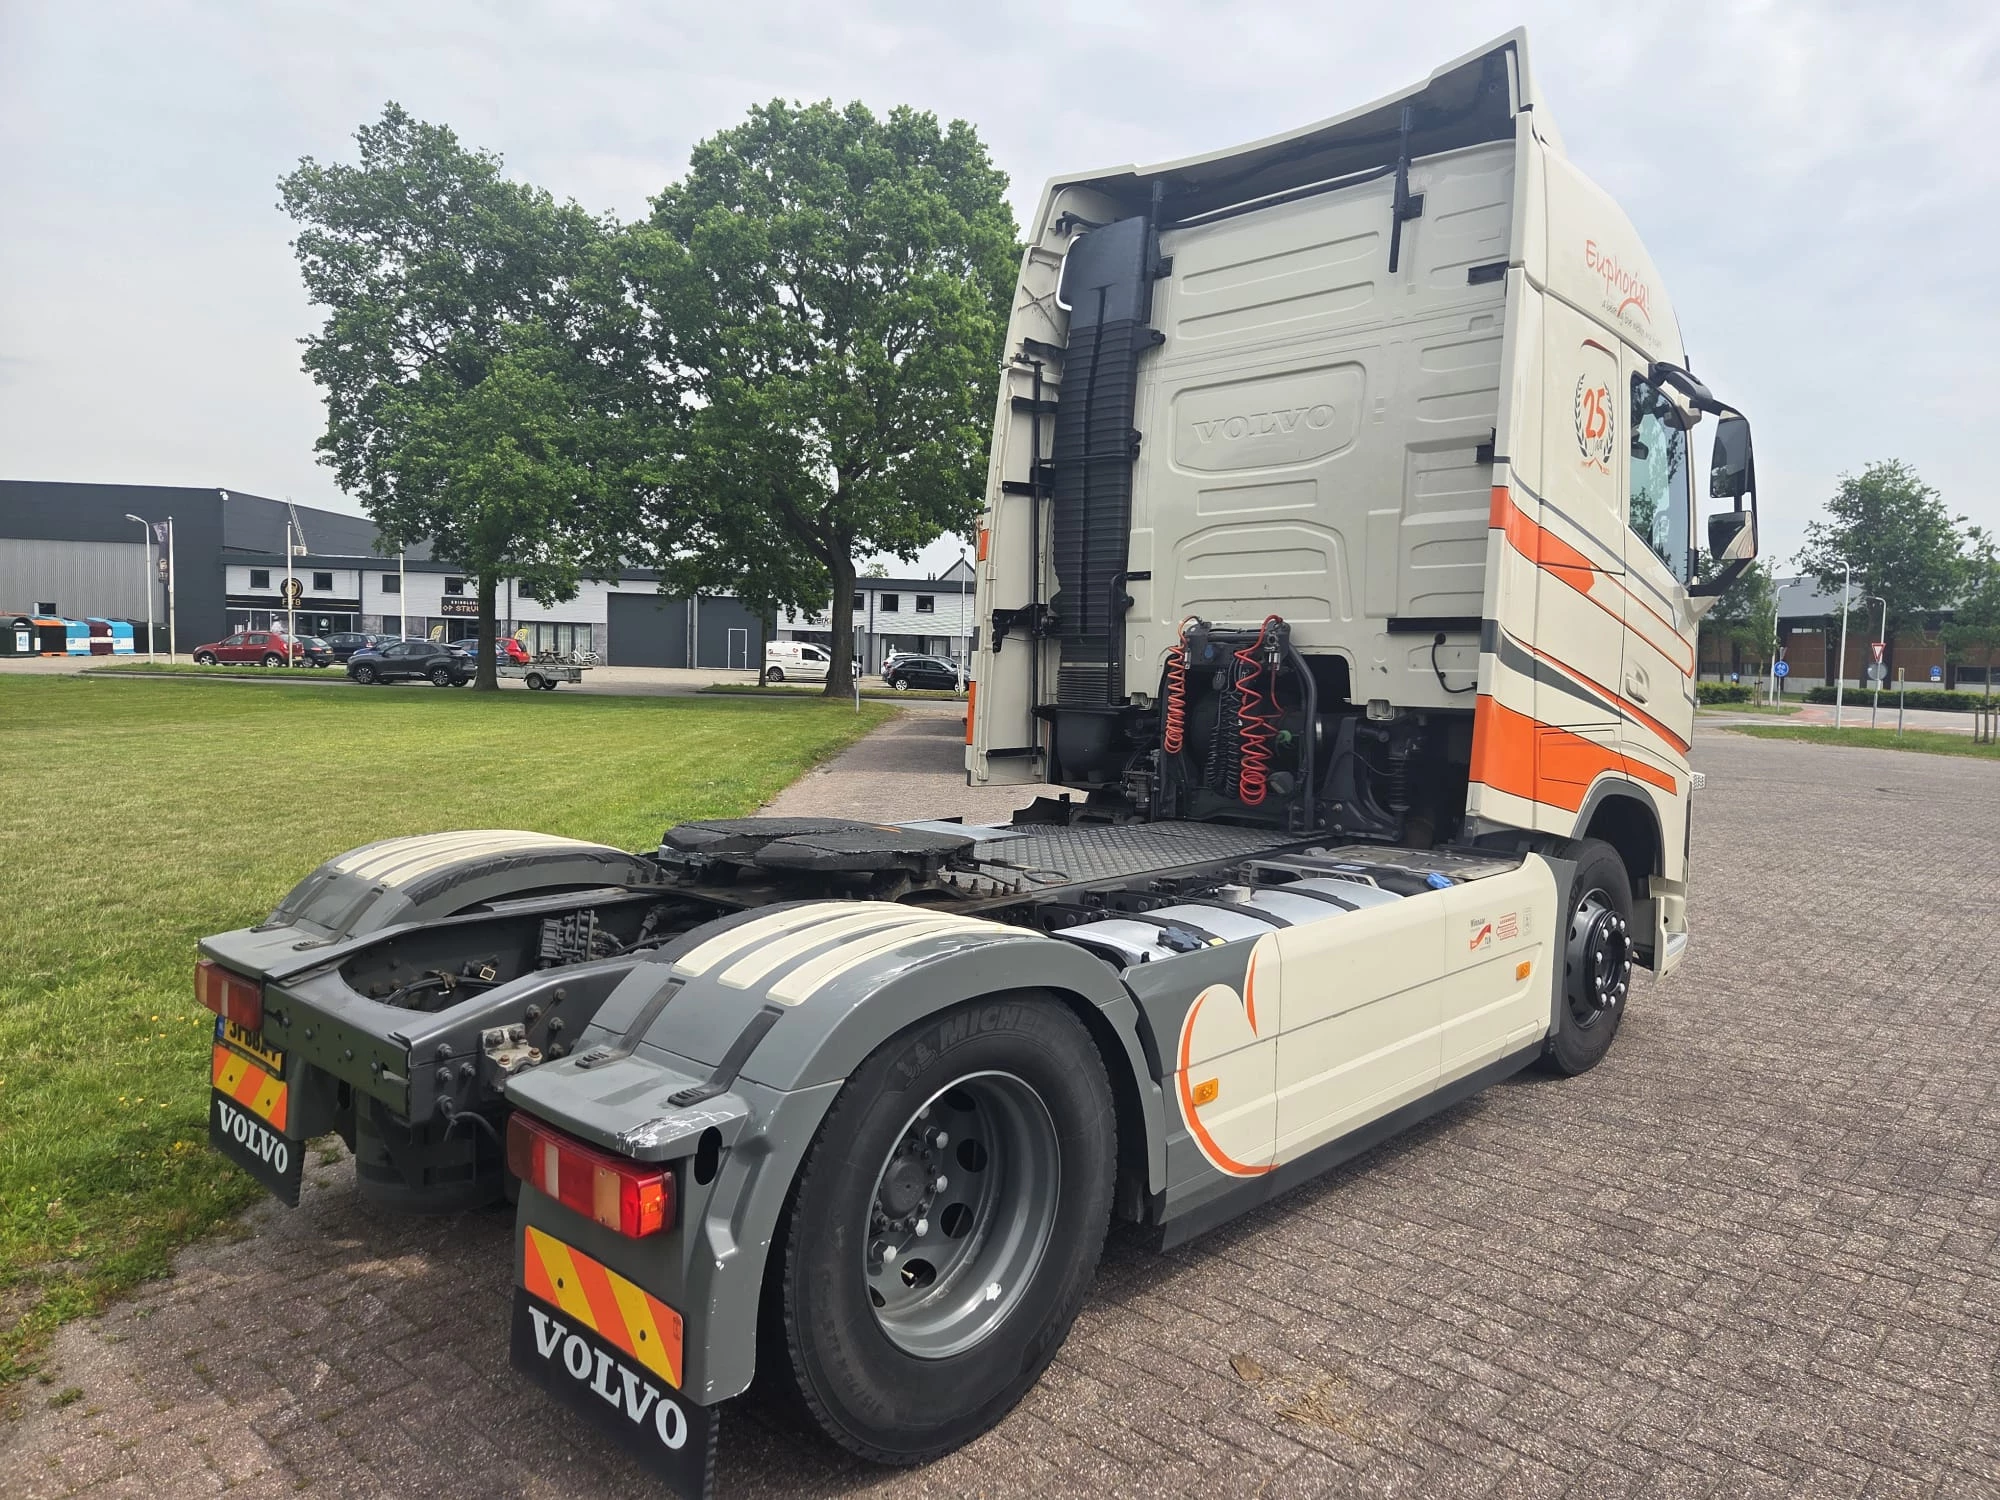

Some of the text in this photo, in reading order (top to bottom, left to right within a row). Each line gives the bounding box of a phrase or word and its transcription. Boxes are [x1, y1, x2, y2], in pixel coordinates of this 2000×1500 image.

[1586, 239, 1650, 312] Euphoria!
[1192, 404, 1336, 443] VOLVO
[1584, 388, 1606, 439] 25
[217, 1099, 289, 1174] VOLVO
[528, 1305, 688, 1450] VOLVO
